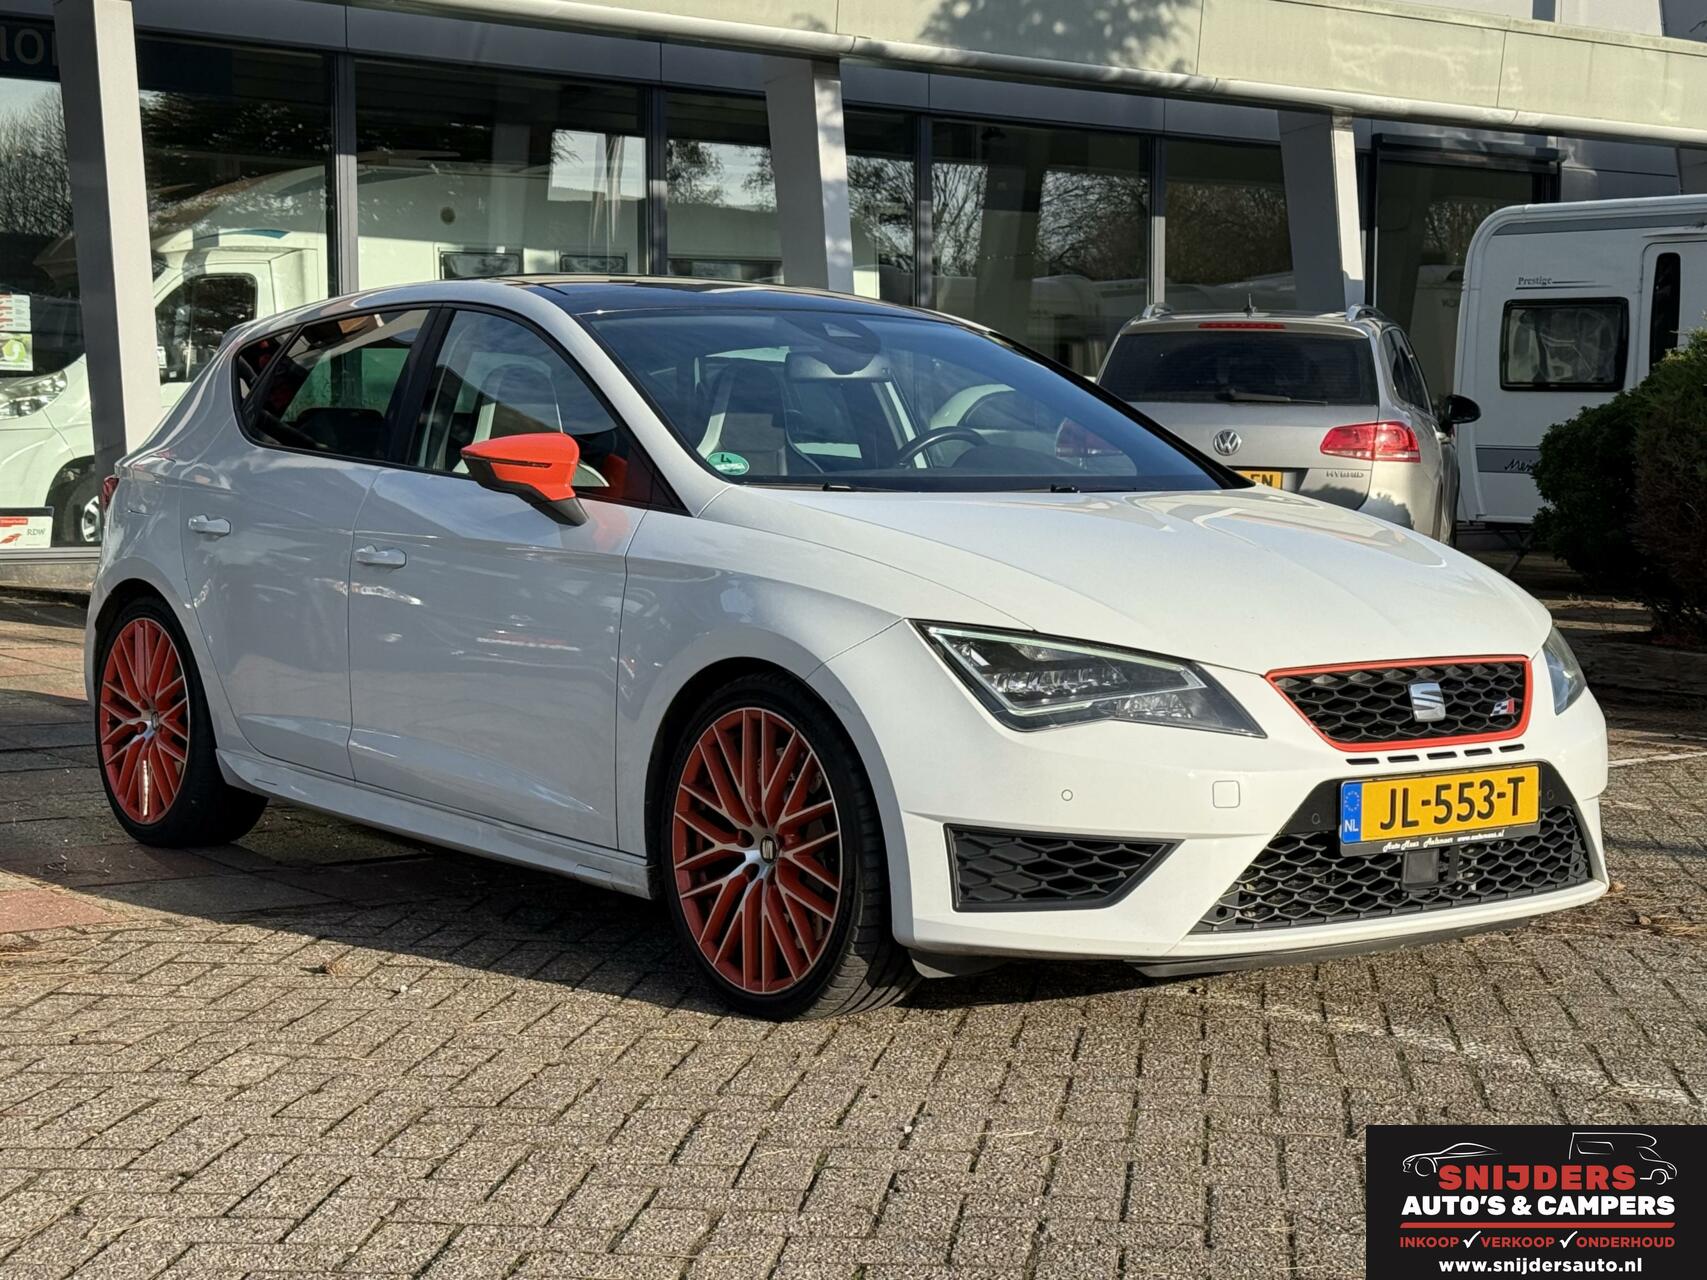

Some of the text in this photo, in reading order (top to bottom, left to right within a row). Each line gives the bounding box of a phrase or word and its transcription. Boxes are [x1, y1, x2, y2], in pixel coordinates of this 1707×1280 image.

[1518, 276, 1553, 286] Prestige
[27, 528, 46, 536] RDW
[1380, 776, 1525, 831] JL-553-T
[1344, 820, 1359, 832] NL
